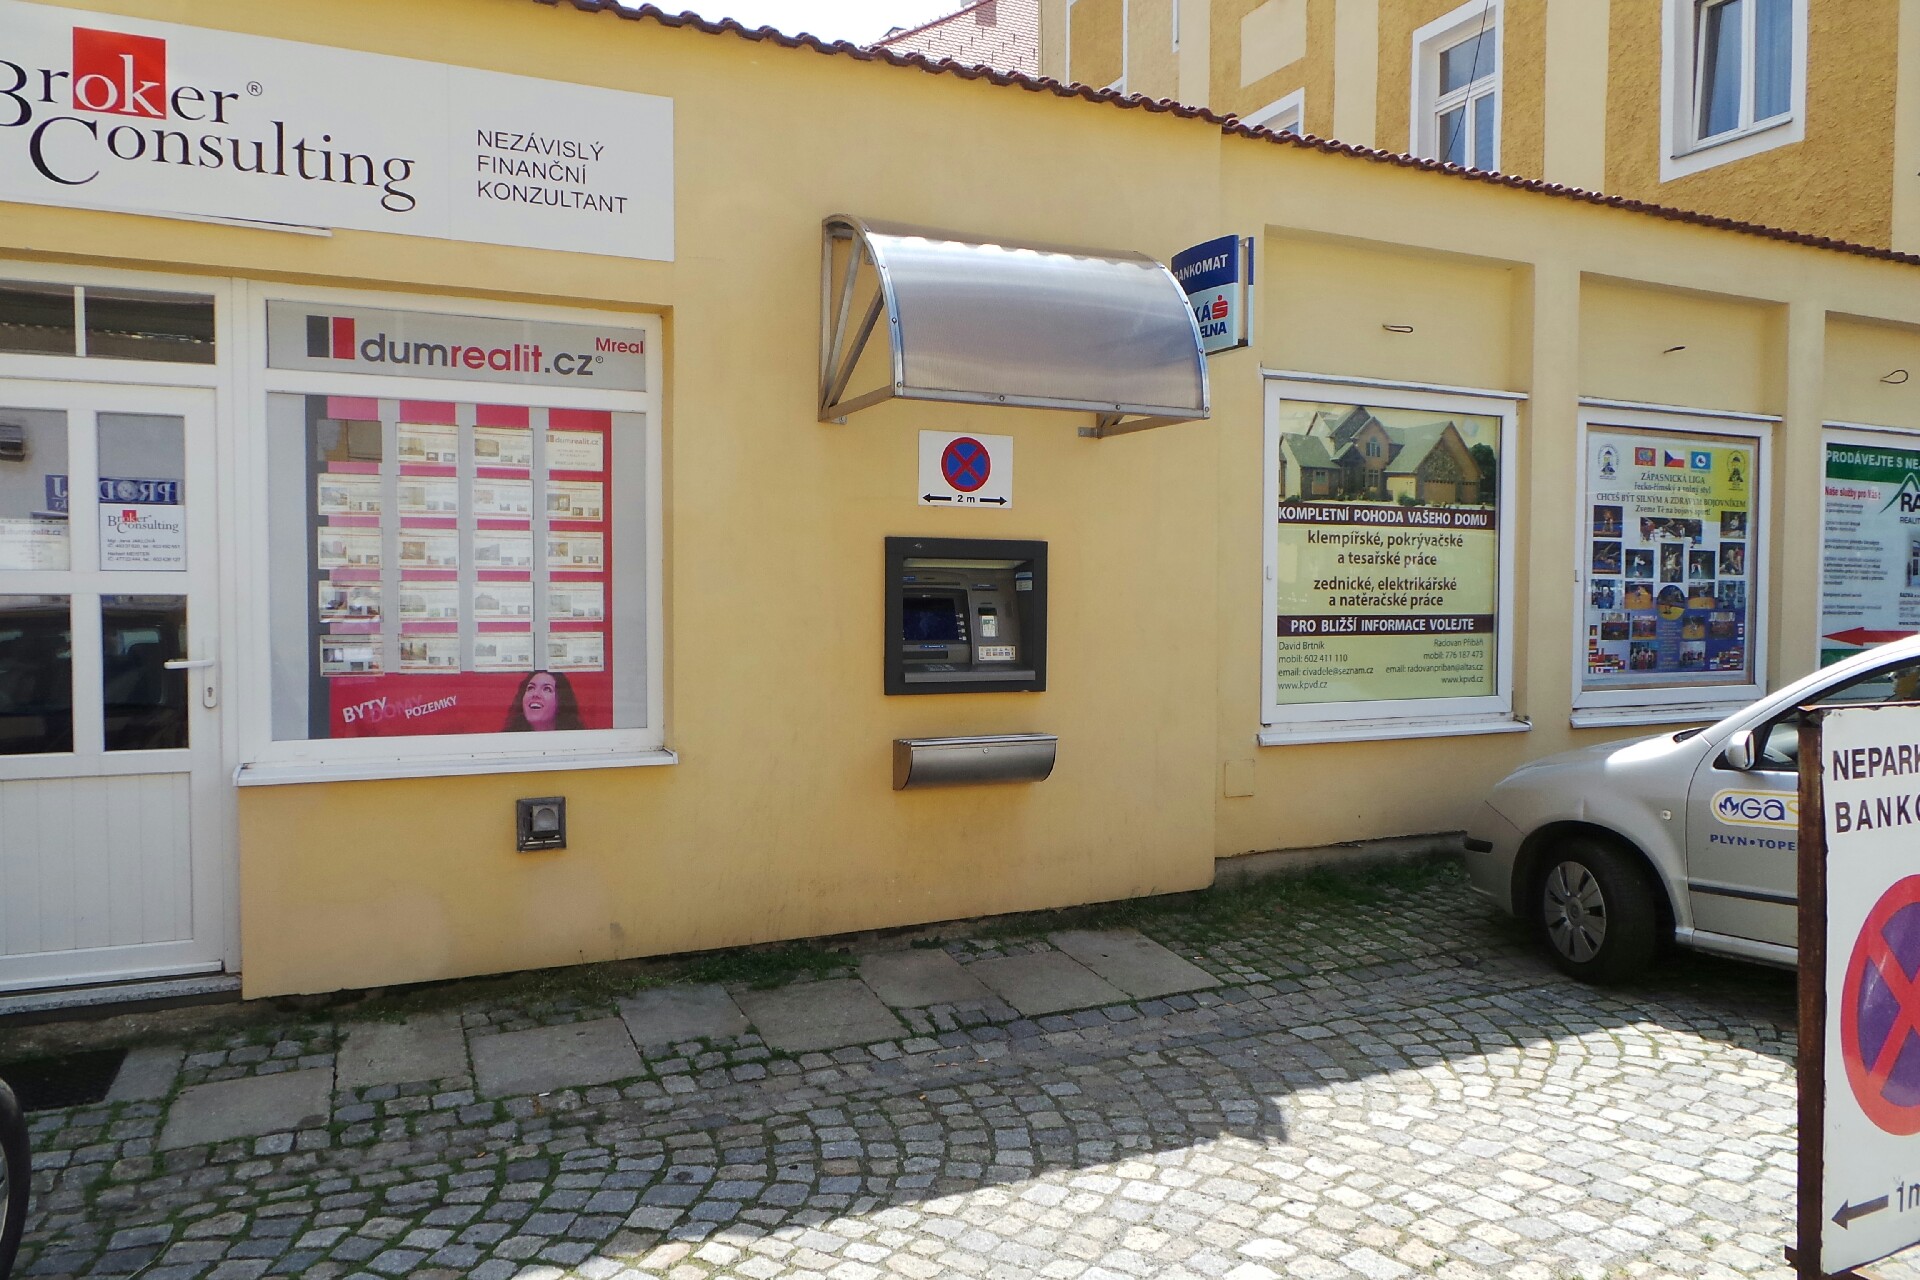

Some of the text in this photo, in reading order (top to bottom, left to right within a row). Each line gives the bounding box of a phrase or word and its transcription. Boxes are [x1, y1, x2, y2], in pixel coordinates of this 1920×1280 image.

[477, 129, 604, 162] NEZÁVISLÝ
[30, 116, 416, 212] Consulting
[477, 155, 587, 185] FINANČNÍ
[477, 180, 628, 214] KONZULTANT
[595, 337, 644, 354] Mreal
[1826, 450, 1894, 468] PRODÁVEJTE
[1896, 456, 1903, 468] S
[1640, 472, 1705, 485] ZÁPASNICKÁ LIGA
[957, 494, 964, 503] 2
[1596, 491, 1620, 502] CHCEŠ
[1621, 492, 1635, 502] BÝT
[1278, 506, 1488, 526] KOMPLETNÍ POHODA VAŠEHO DOMU
[117, 518, 179, 533] Consulting
[1307, 529, 1463, 549] klempířské, pokrývačské
[1337, 551, 1437, 568] a tesařské práce
[1314, 576, 1457, 592] zednické, elektrikářské
[1329, 593, 1443, 609] a natěračské práce
[1291, 616, 1475, 632] PRO BLIŽŠÍ INFORMACE VOLEJTE
[1279, 641, 1300, 650] David
[1434, 638, 1461, 647] Radovan
[1278, 653, 1348, 663] mobil: 602 411 110
[1278, 667, 1301, 677] email:
[342, 696, 387, 723] BYTY
[404, 695, 457, 719] POZEMKY
[1835, 794, 1920, 833] BANK
